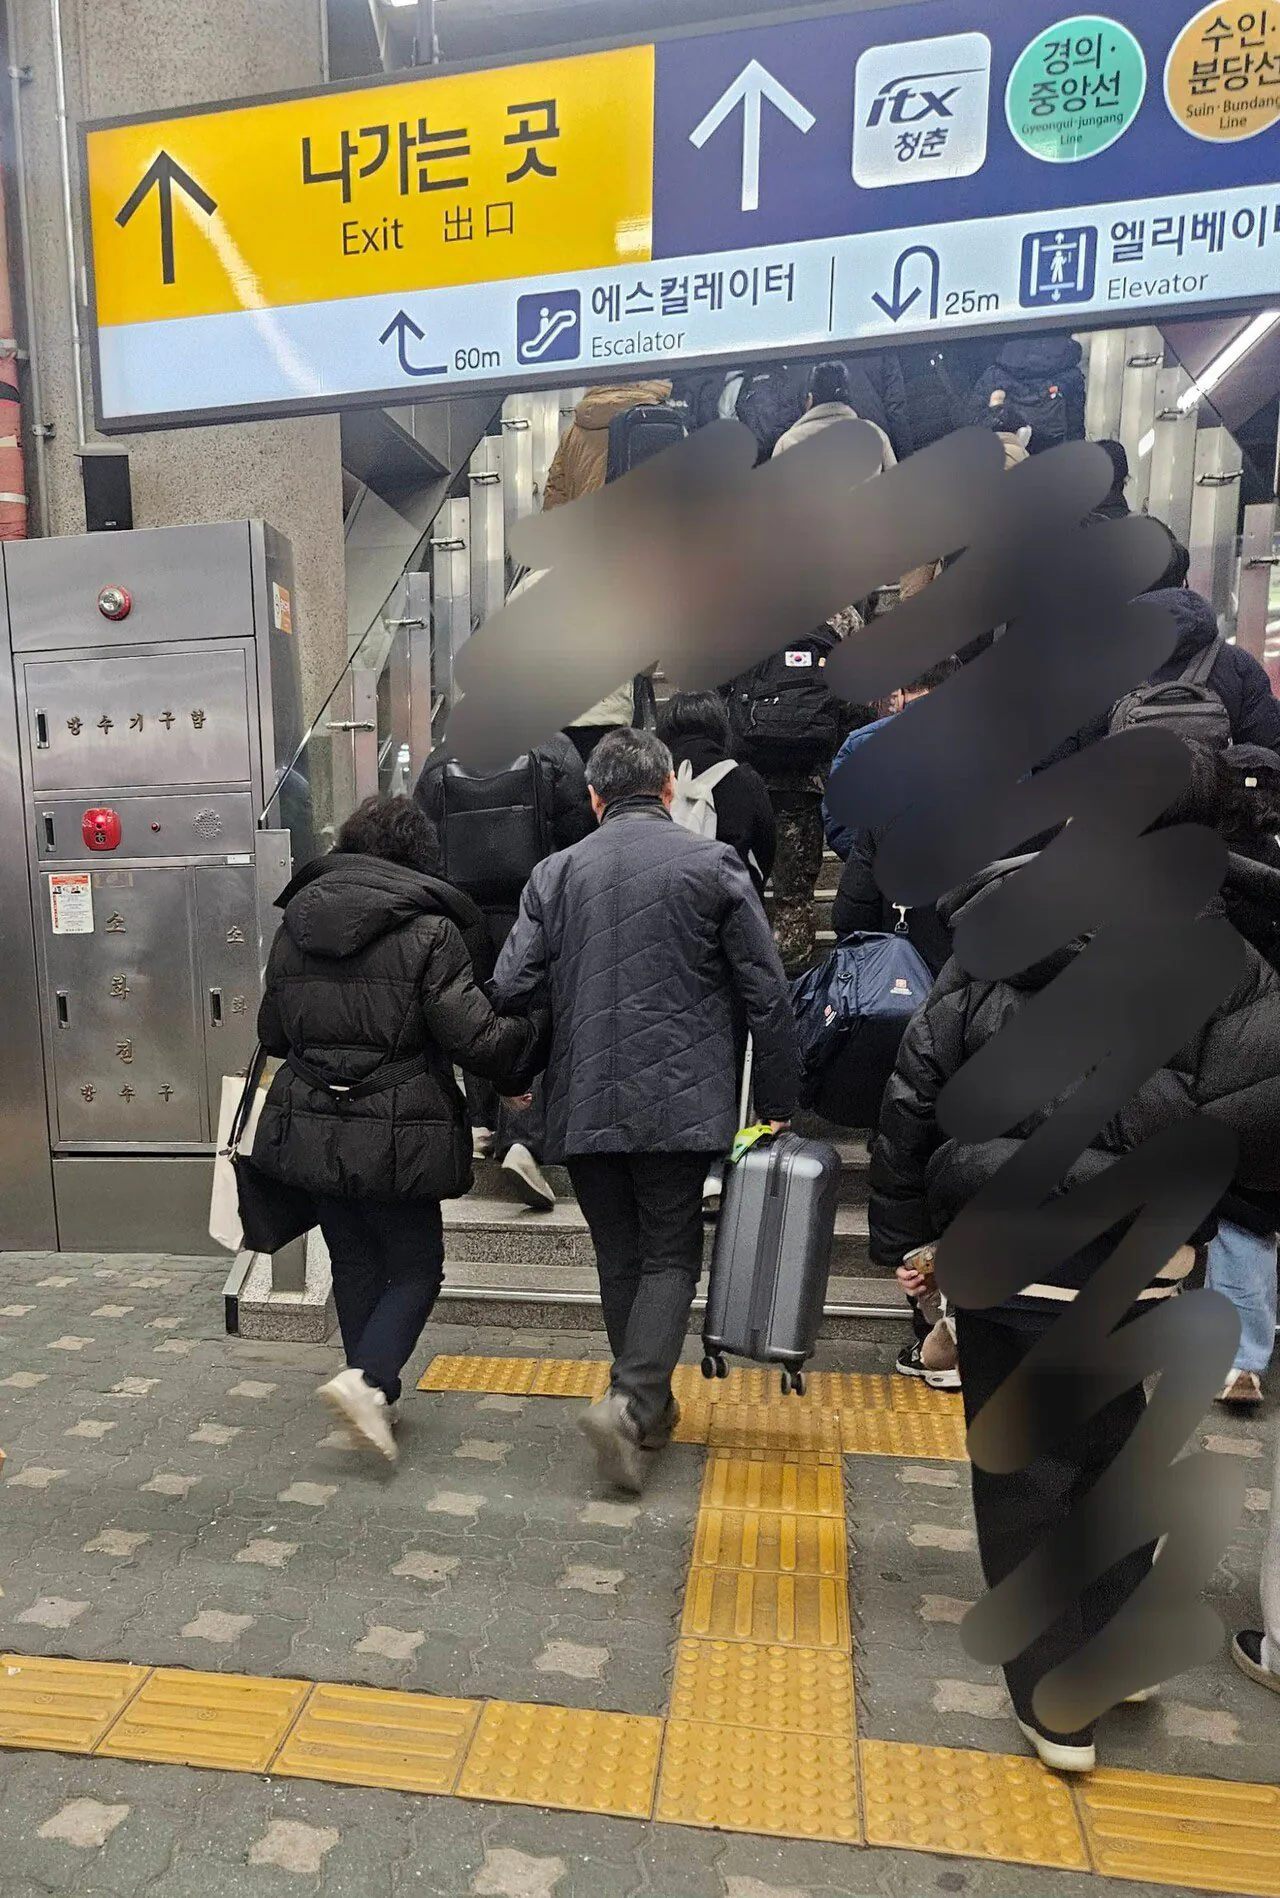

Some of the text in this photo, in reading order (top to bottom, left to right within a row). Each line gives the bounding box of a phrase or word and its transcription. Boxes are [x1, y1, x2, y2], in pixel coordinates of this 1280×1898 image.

[1188, 51, 1280, 96] 분당선
[1029, 70, 1121, 117] 중앙선
[1219, 115, 1248, 130] Line
[301, 98, 560, 204] 나가는 곳
[894, 127, 949, 162] 청춘
[1060, 133, 1083, 146] Line
[342, 217, 404, 256] Exit
[443, 201, 514, 243] 出口
[592, 262, 796, 323] 에스컬레이터
[1107, 273, 1209, 301] Elevator
[945, 289, 999, 316] 25m
[591, 330, 686, 359] Escalator
[454, 348, 501, 371] 60m
[66, 708, 207, 737] 방수기구함
[80, 1083, 174, 1104] 방수구
